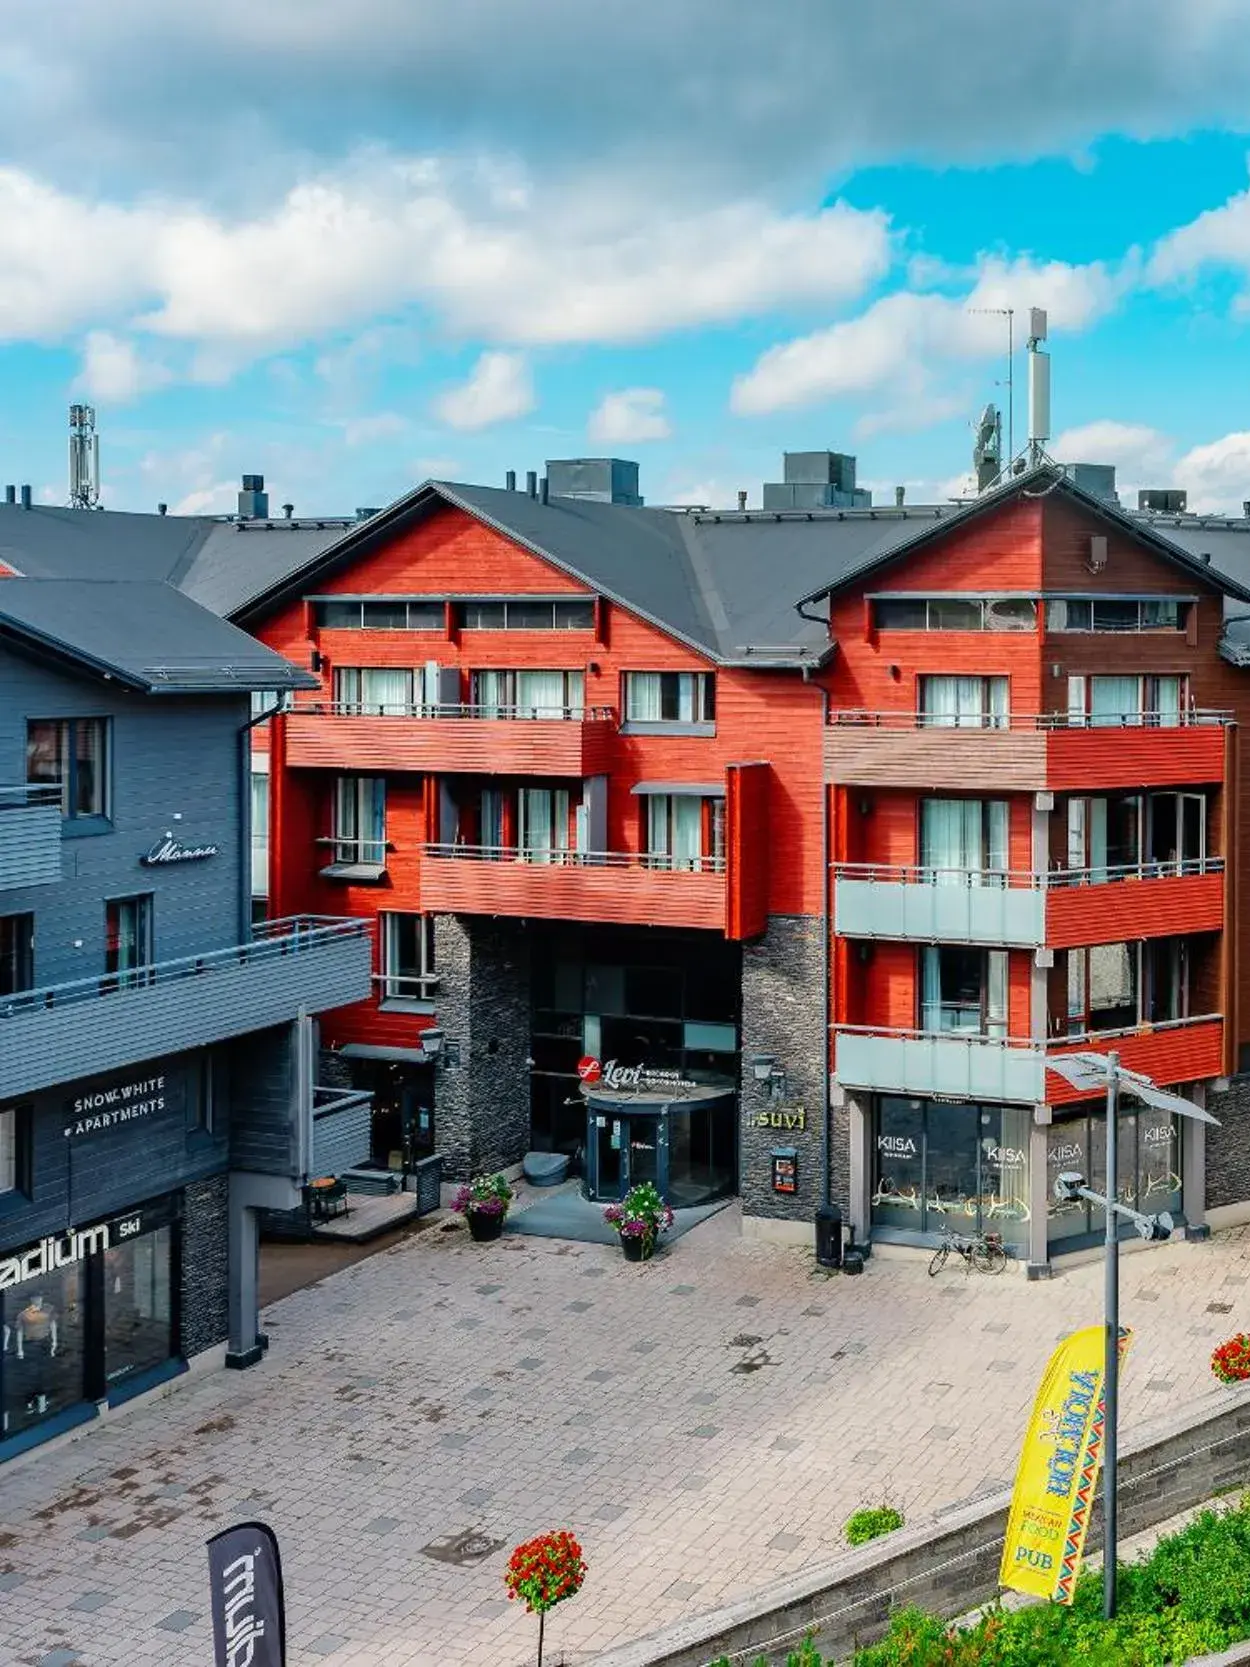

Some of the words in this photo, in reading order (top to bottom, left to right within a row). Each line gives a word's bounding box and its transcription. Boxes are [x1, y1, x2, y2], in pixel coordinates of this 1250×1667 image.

[602, 1059, 644, 1089] Levi
[74, 1089, 118, 1113] SNOW
[121, 1076, 165, 1099] WHITE
[76, 1097, 165, 1135] APARTMENTS
[119, 1218, 140, 1238] Ski
[1015, 1546, 1054, 1570] PUB
